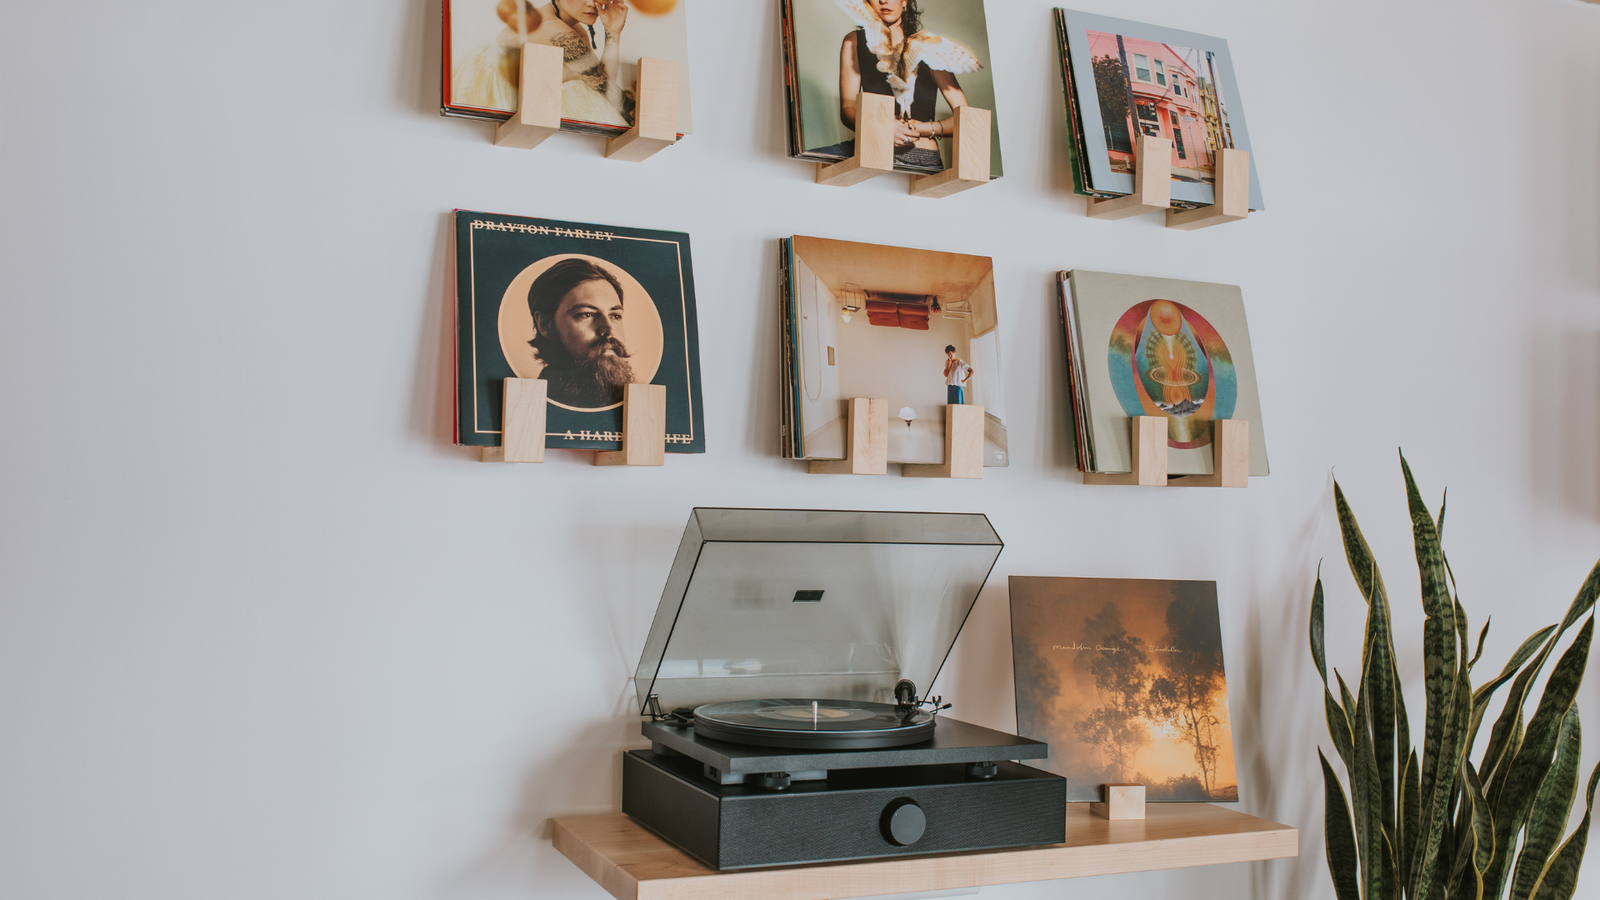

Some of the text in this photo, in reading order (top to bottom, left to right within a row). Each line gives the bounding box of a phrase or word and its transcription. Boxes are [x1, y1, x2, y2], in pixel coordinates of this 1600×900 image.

[473, 219, 614, 241] DRAYTON FARLEY
[563, 429, 691, 444] A HARD IFE
